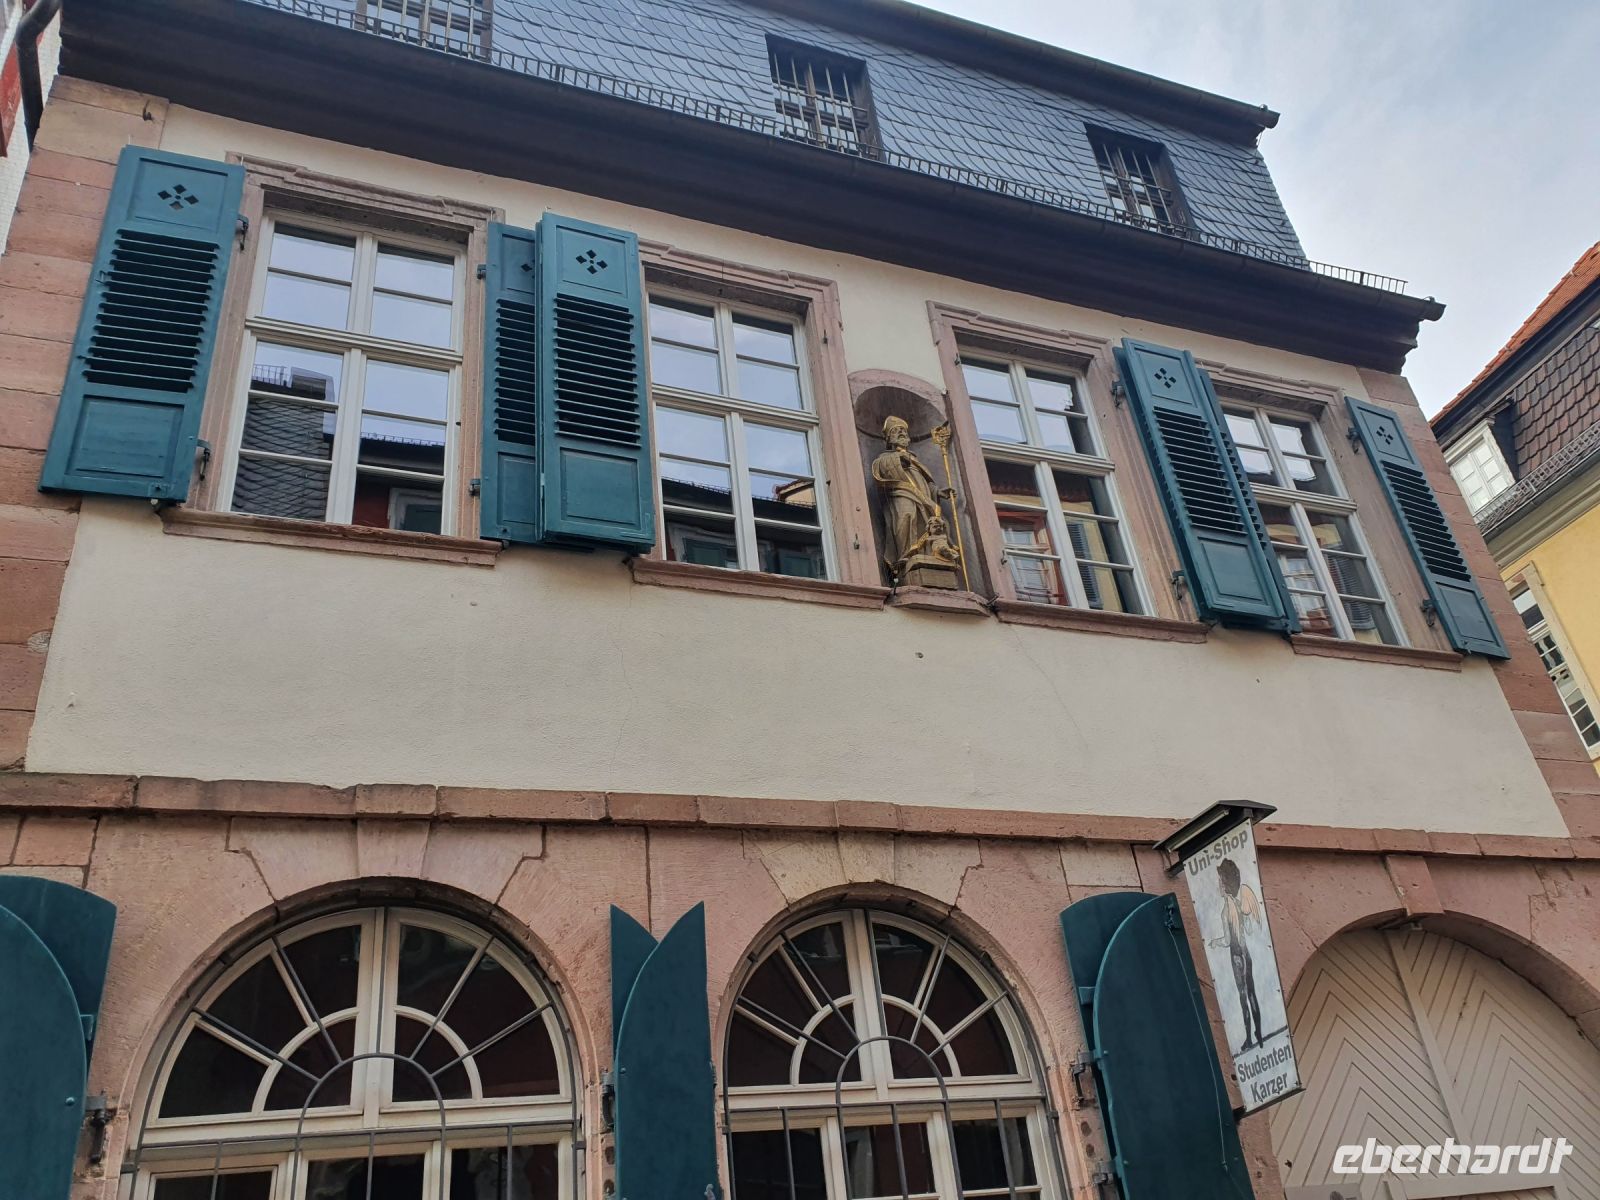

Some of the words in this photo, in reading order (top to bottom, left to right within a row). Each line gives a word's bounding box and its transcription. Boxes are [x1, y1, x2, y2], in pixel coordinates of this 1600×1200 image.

[1188, 830, 1248, 876] Uni-Shop
[1238, 1045, 1292, 1083] Studenten
[1251, 1072, 1288, 1102] Karzer
